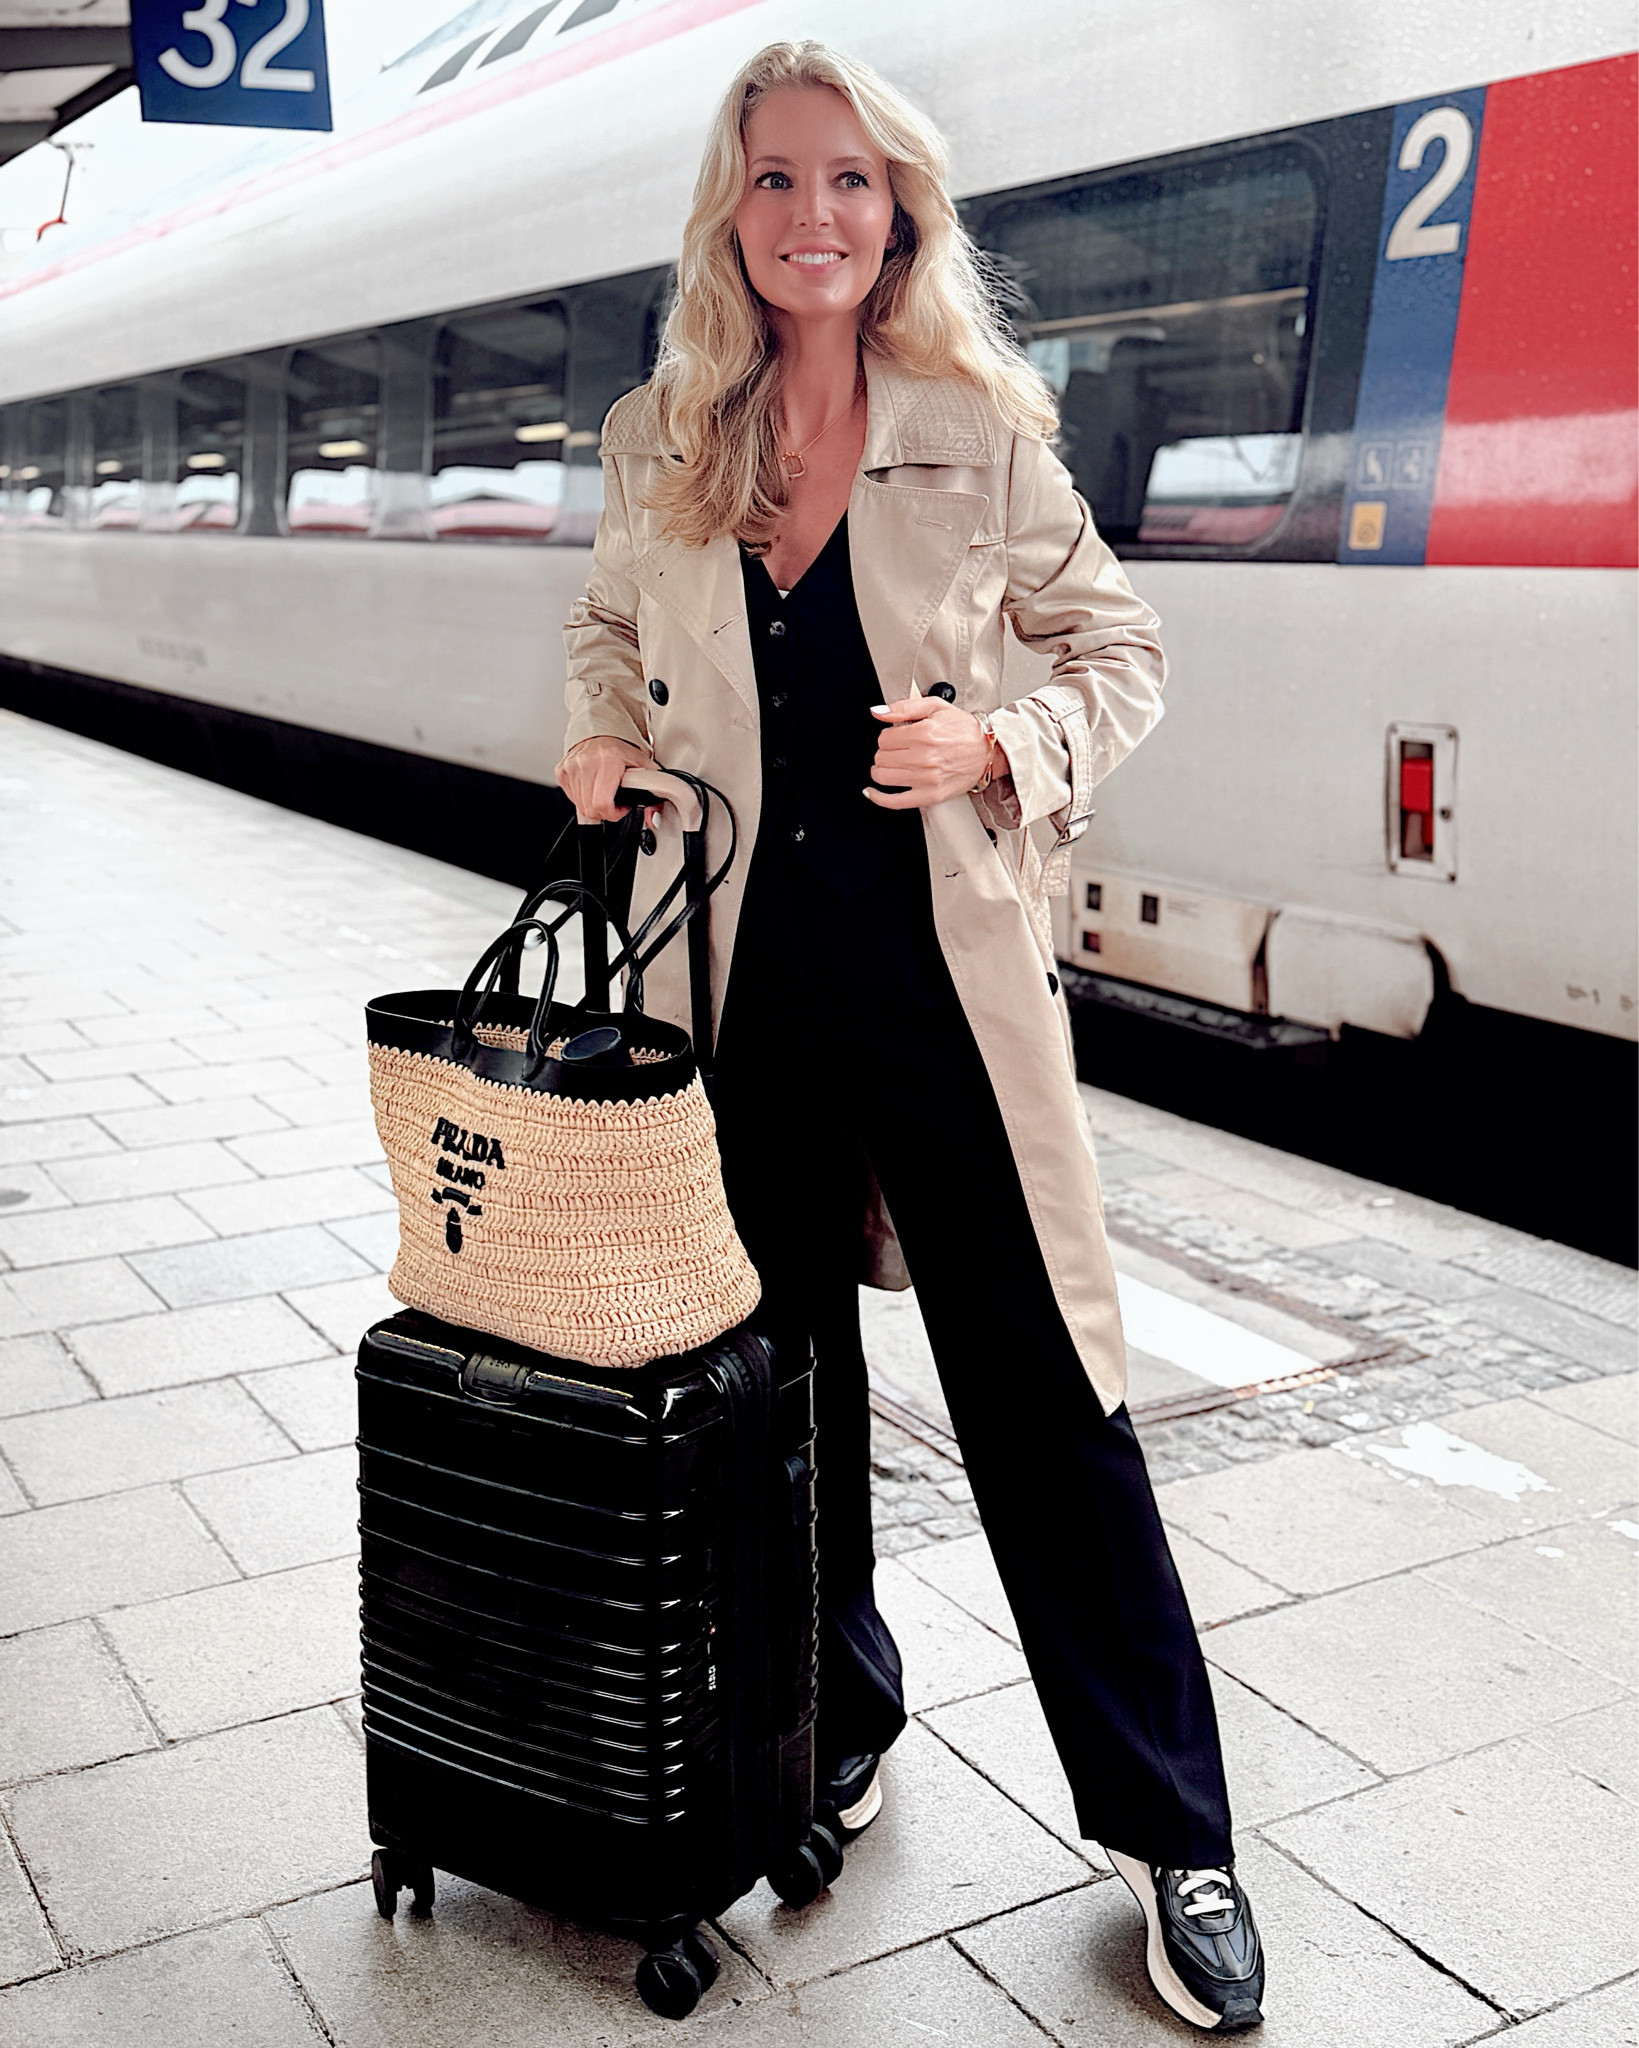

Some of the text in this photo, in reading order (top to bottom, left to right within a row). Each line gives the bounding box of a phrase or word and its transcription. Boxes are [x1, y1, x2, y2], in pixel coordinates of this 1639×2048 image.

[158, 0, 316, 92] 32
[1385, 106, 1473, 262] 2
[430, 1116, 506, 1170] PRADA
